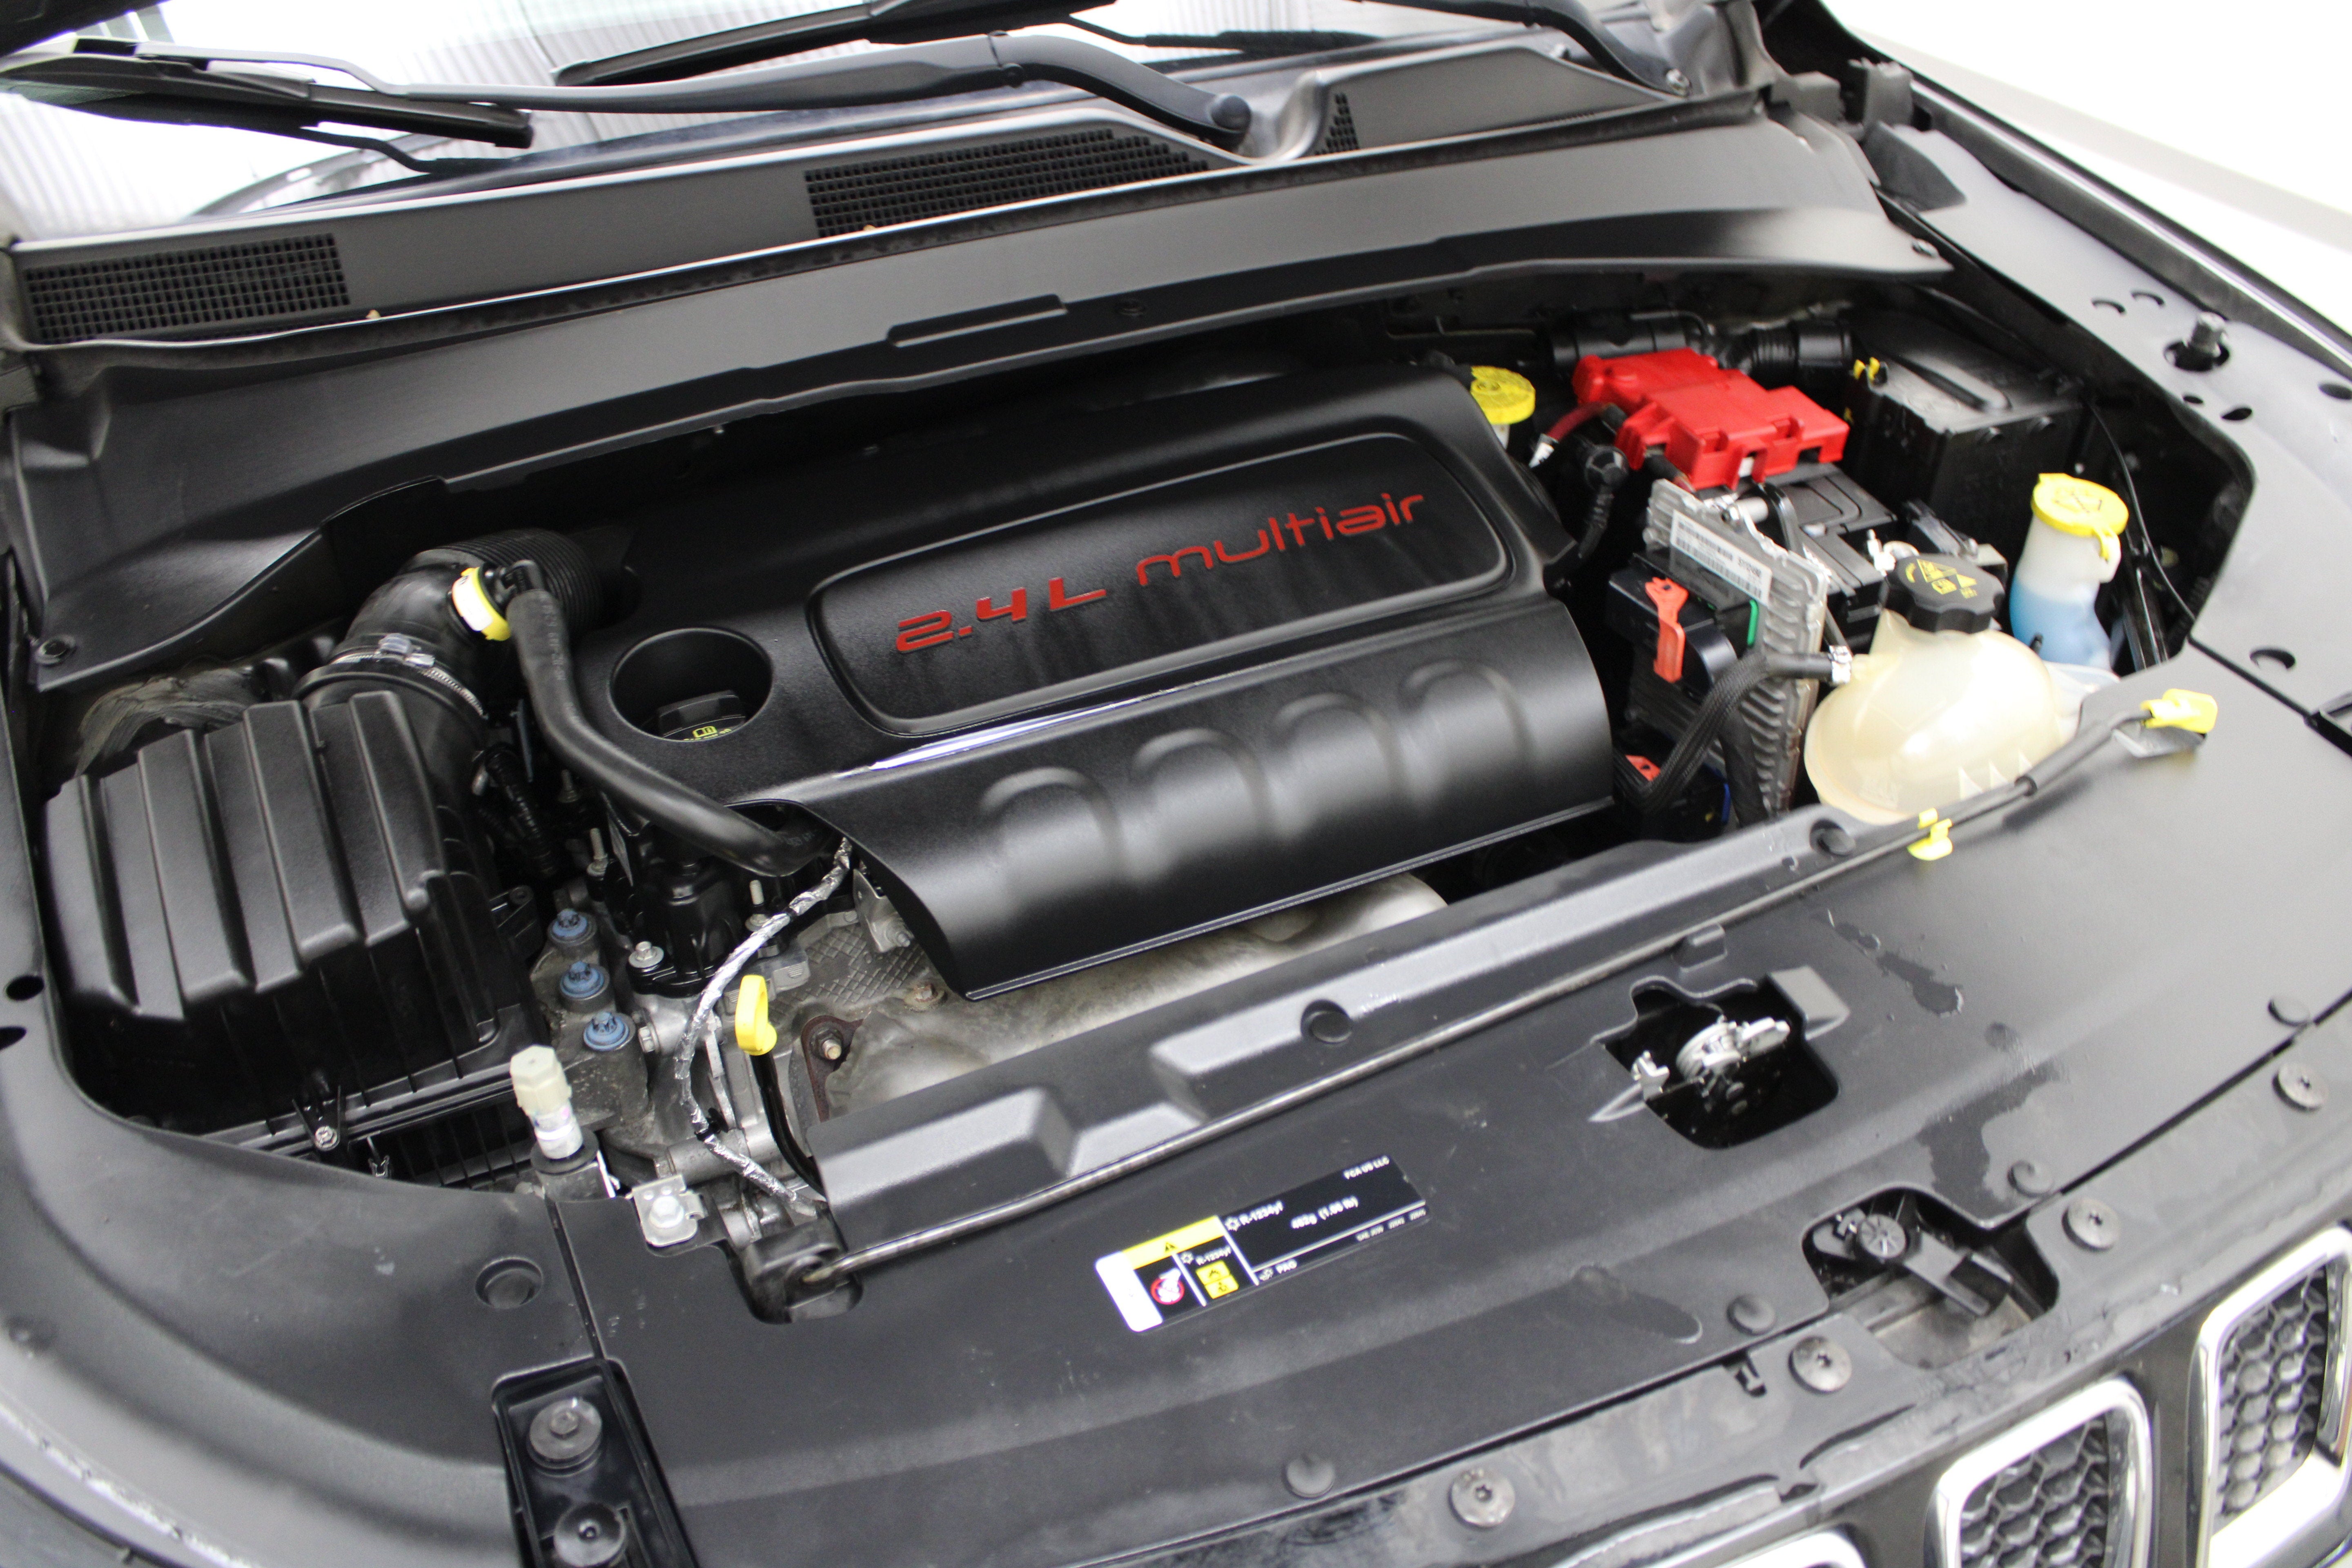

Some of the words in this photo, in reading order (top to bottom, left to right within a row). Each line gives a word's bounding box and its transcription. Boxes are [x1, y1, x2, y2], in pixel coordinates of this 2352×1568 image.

[1136, 493, 1423, 585] multiair
[1343, 1167, 1363, 1180] FCA
[1239, 1200, 1284, 1225] R-1234yf
[1275, 1258, 1298, 1274] PAG
